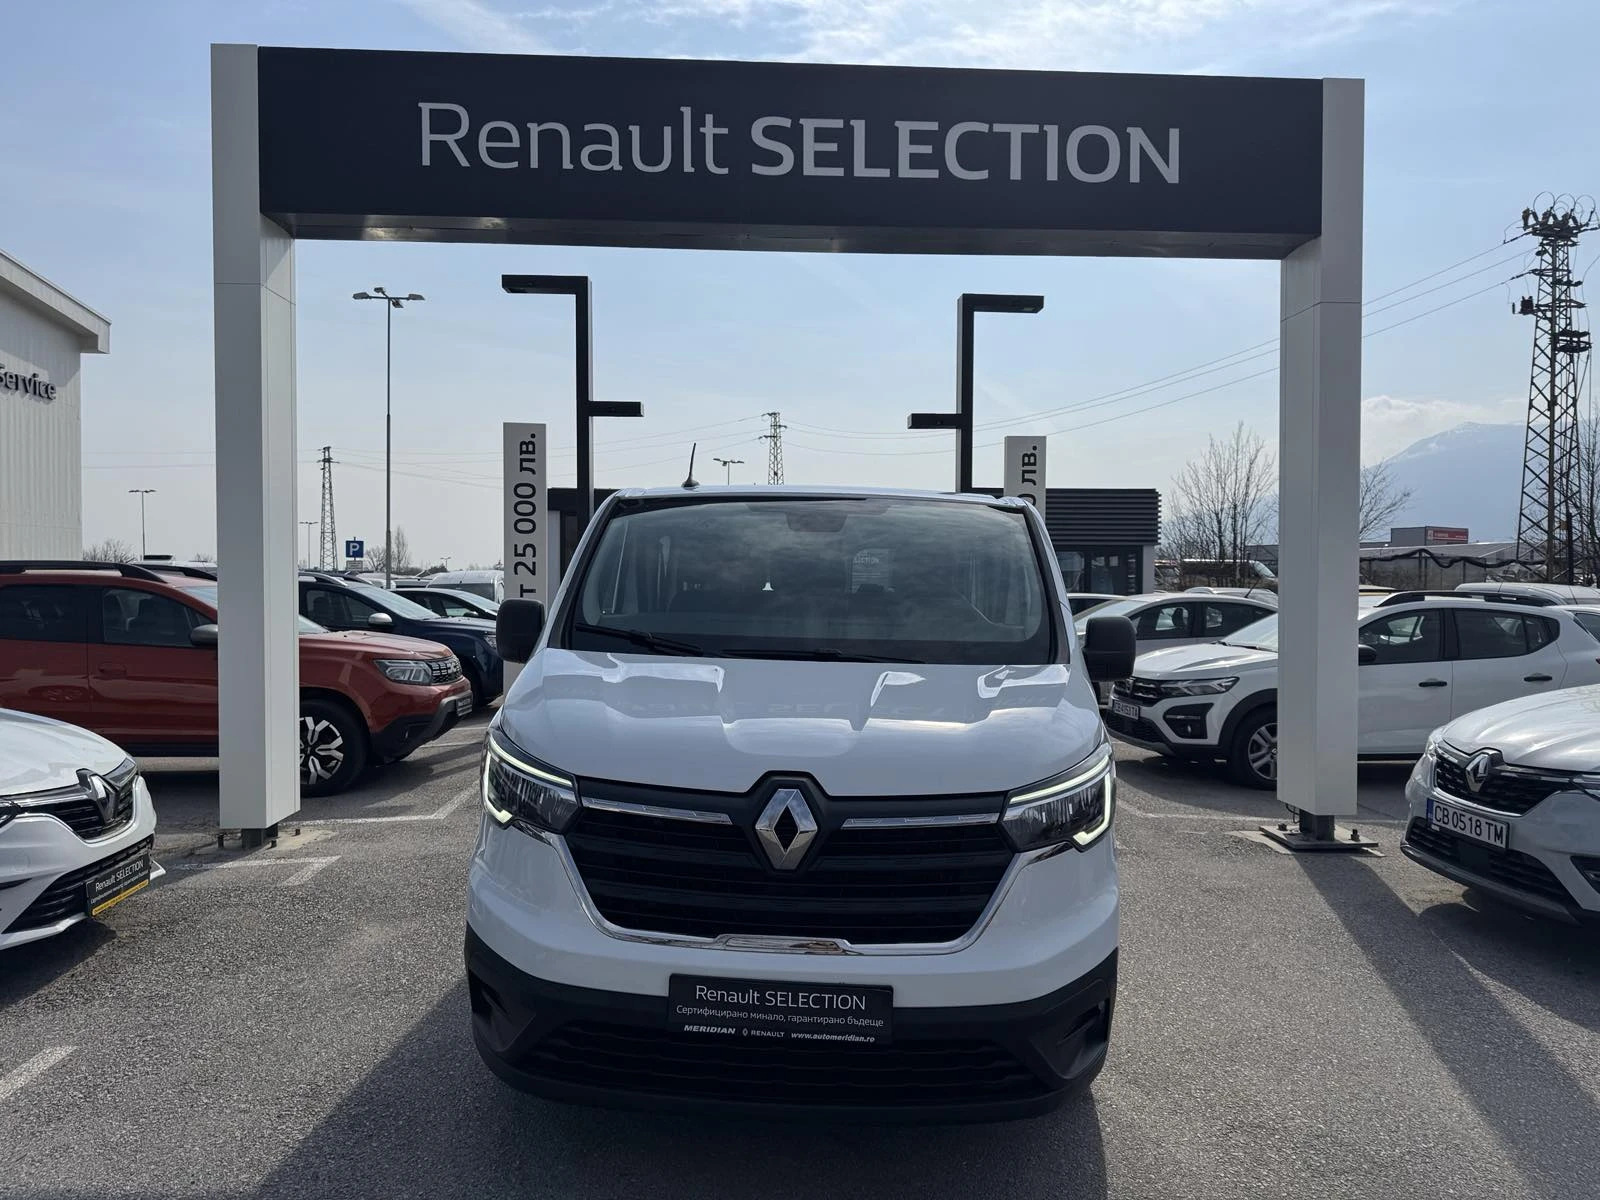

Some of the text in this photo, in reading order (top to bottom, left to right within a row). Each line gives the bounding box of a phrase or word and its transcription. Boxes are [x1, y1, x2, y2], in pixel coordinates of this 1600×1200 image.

[418, 102, 1180, 184] Renault SELECTION
[519, 433, 537, 475] лв.
[1021, 445, 1038, 486] лв.
[513, 482, 537, 535] 000
[350, 542, 360, 556] P
[513, 543, 537, 576] 25
[95, 874, 116, 892] Renault
[115, 859, 144, 882] SELECTION
[695, 984, 866, 1010] Renault SELECTION
[676, 1004, 885, 1027] Сертифицирано минало, гарантирано бъдеще
[683, 1024, 736, 1035] MERIDIAN
[750, 1029, 785, 1039] RENAULT
